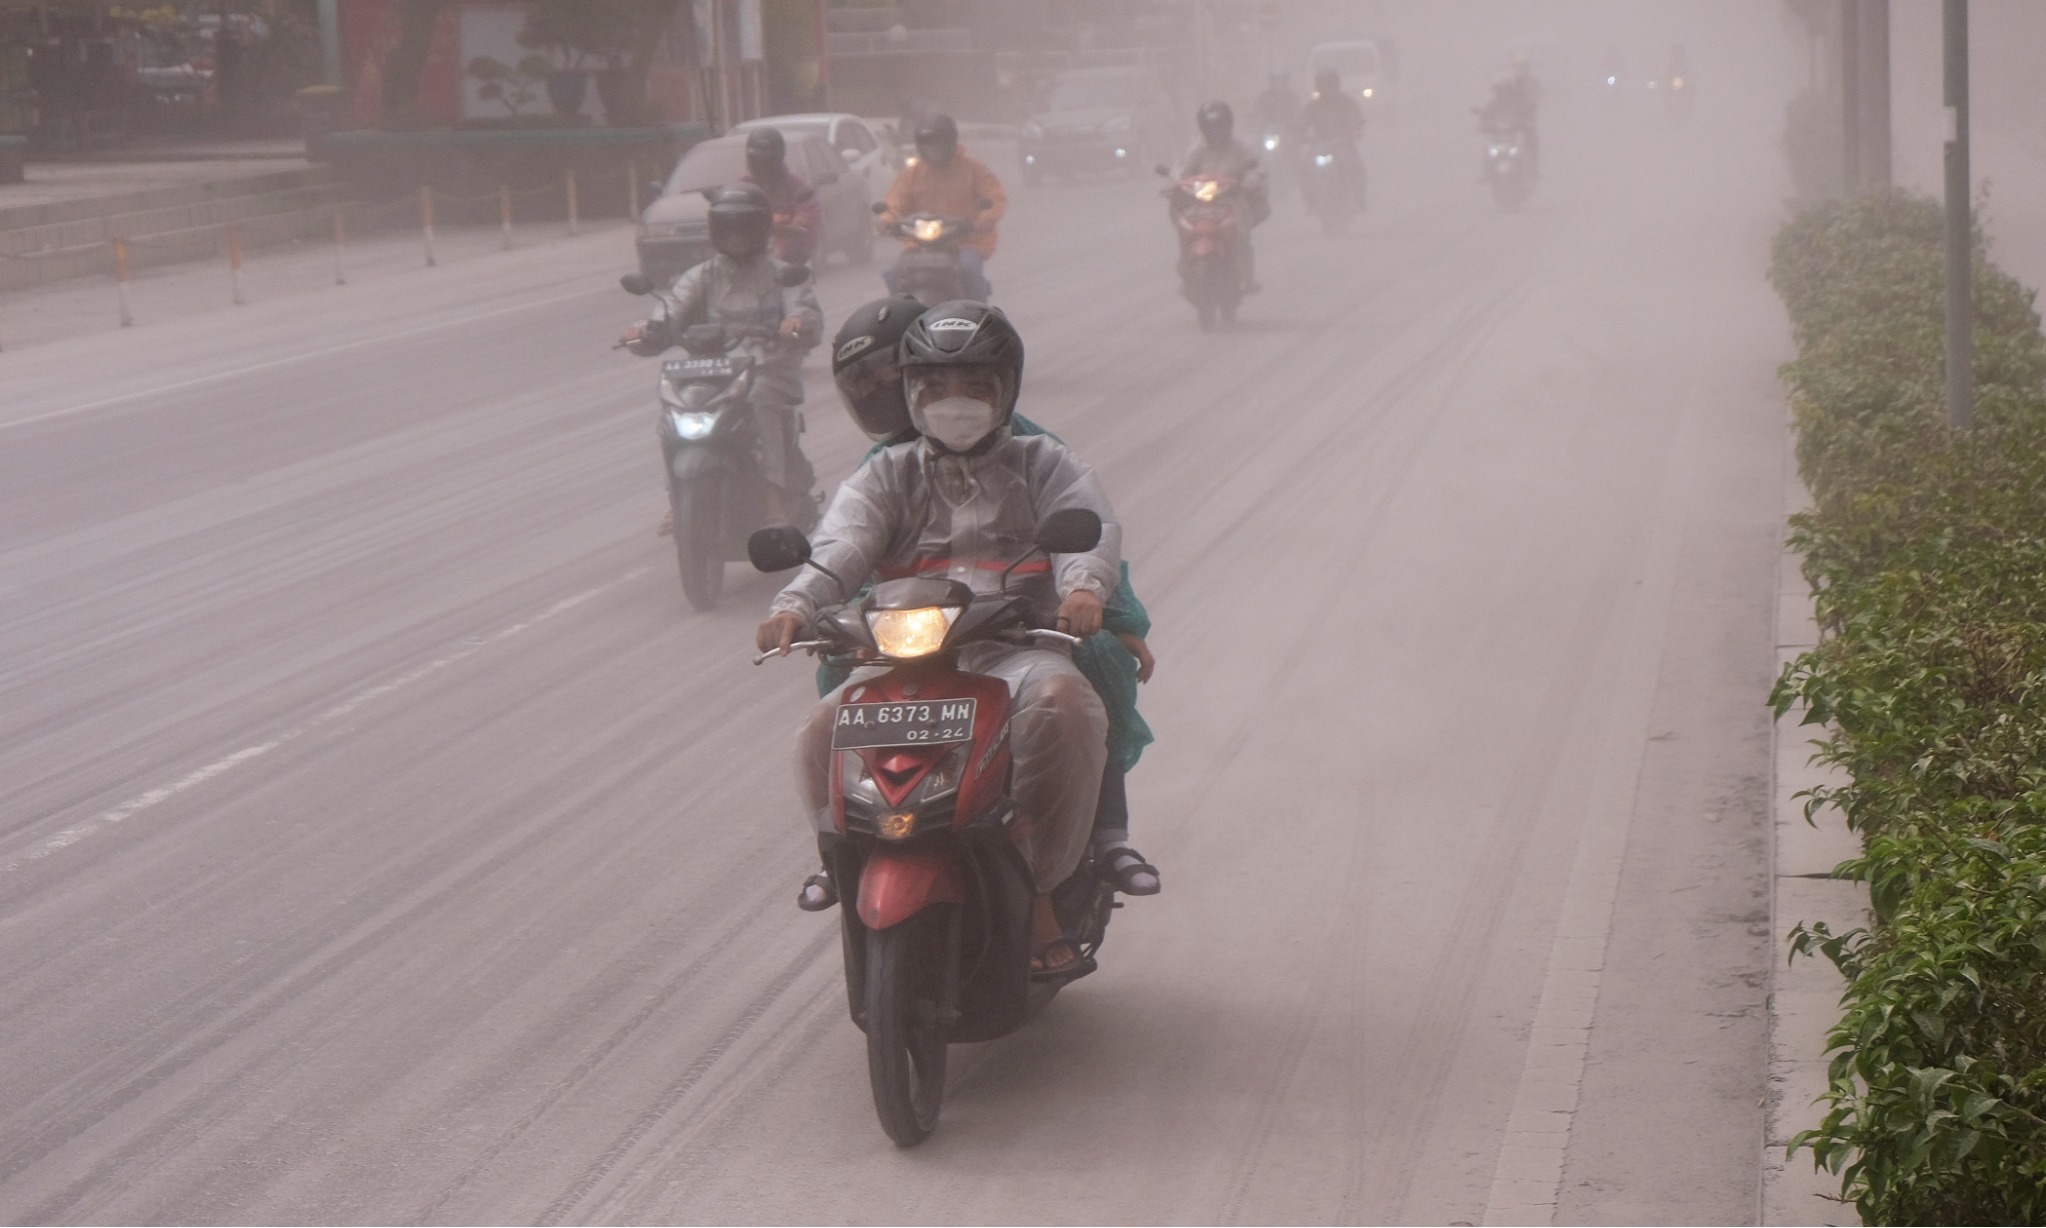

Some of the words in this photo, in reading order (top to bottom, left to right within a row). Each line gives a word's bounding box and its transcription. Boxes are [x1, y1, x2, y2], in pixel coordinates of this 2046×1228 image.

[934, 320, 972, 328] INK
[665, 362, 680, 371] AA
[838, 708, 865, 726] AA
[877, 704, 931, 724] 6373
[940, 703, 970, 722] MN
